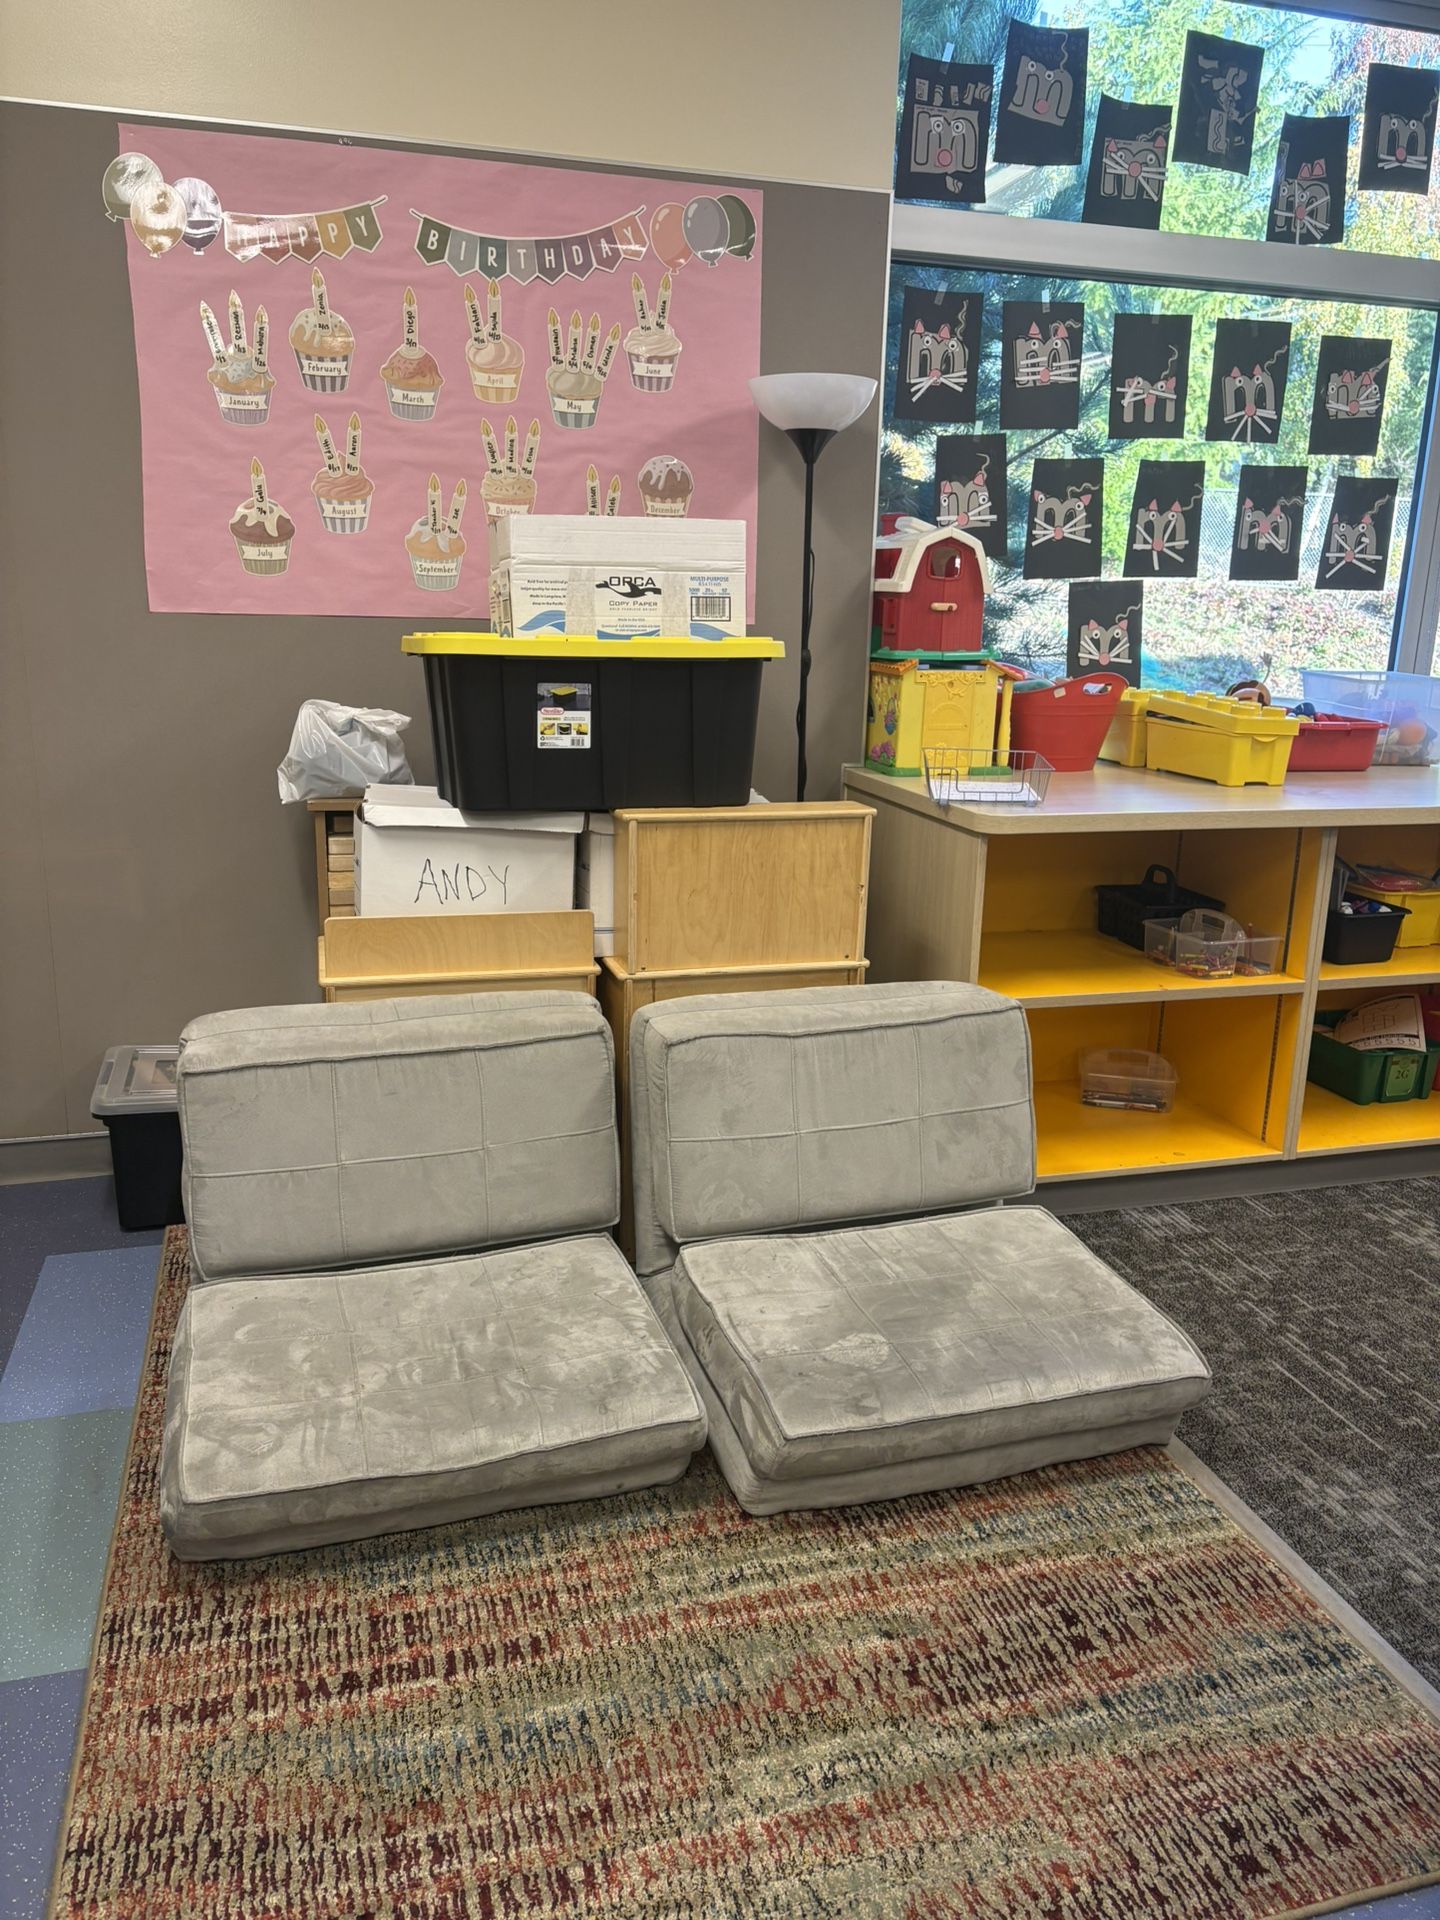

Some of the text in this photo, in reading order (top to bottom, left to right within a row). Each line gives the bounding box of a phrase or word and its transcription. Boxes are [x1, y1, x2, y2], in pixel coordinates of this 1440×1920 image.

[237, 214, 634, 269] HAPPY BIRTHDAY
[317, 293, 326, 315] Zenia
[407, 311, 415, 334] Diego
[470, 304, 481, 333] Fabian
[307, 363, 342, 376] February
[645, 366, 661, 376] June
[487, 374, 504, 386] April
[228, 396, 260, 408] January
[402, 394, 424, 404] March
[566, 401, 582, 412] May
[323, 439, 334, 460] Edith
[332, 506, 357, 516] August
[496, 506, 520, 514] October
[651, 504, 681, 514] December
[257, 548, 273, 559] July
[418, 564, 455, 574] September
[609, 576, 657, 587] ORCA
[414, 858, 509, 904] ANDY
